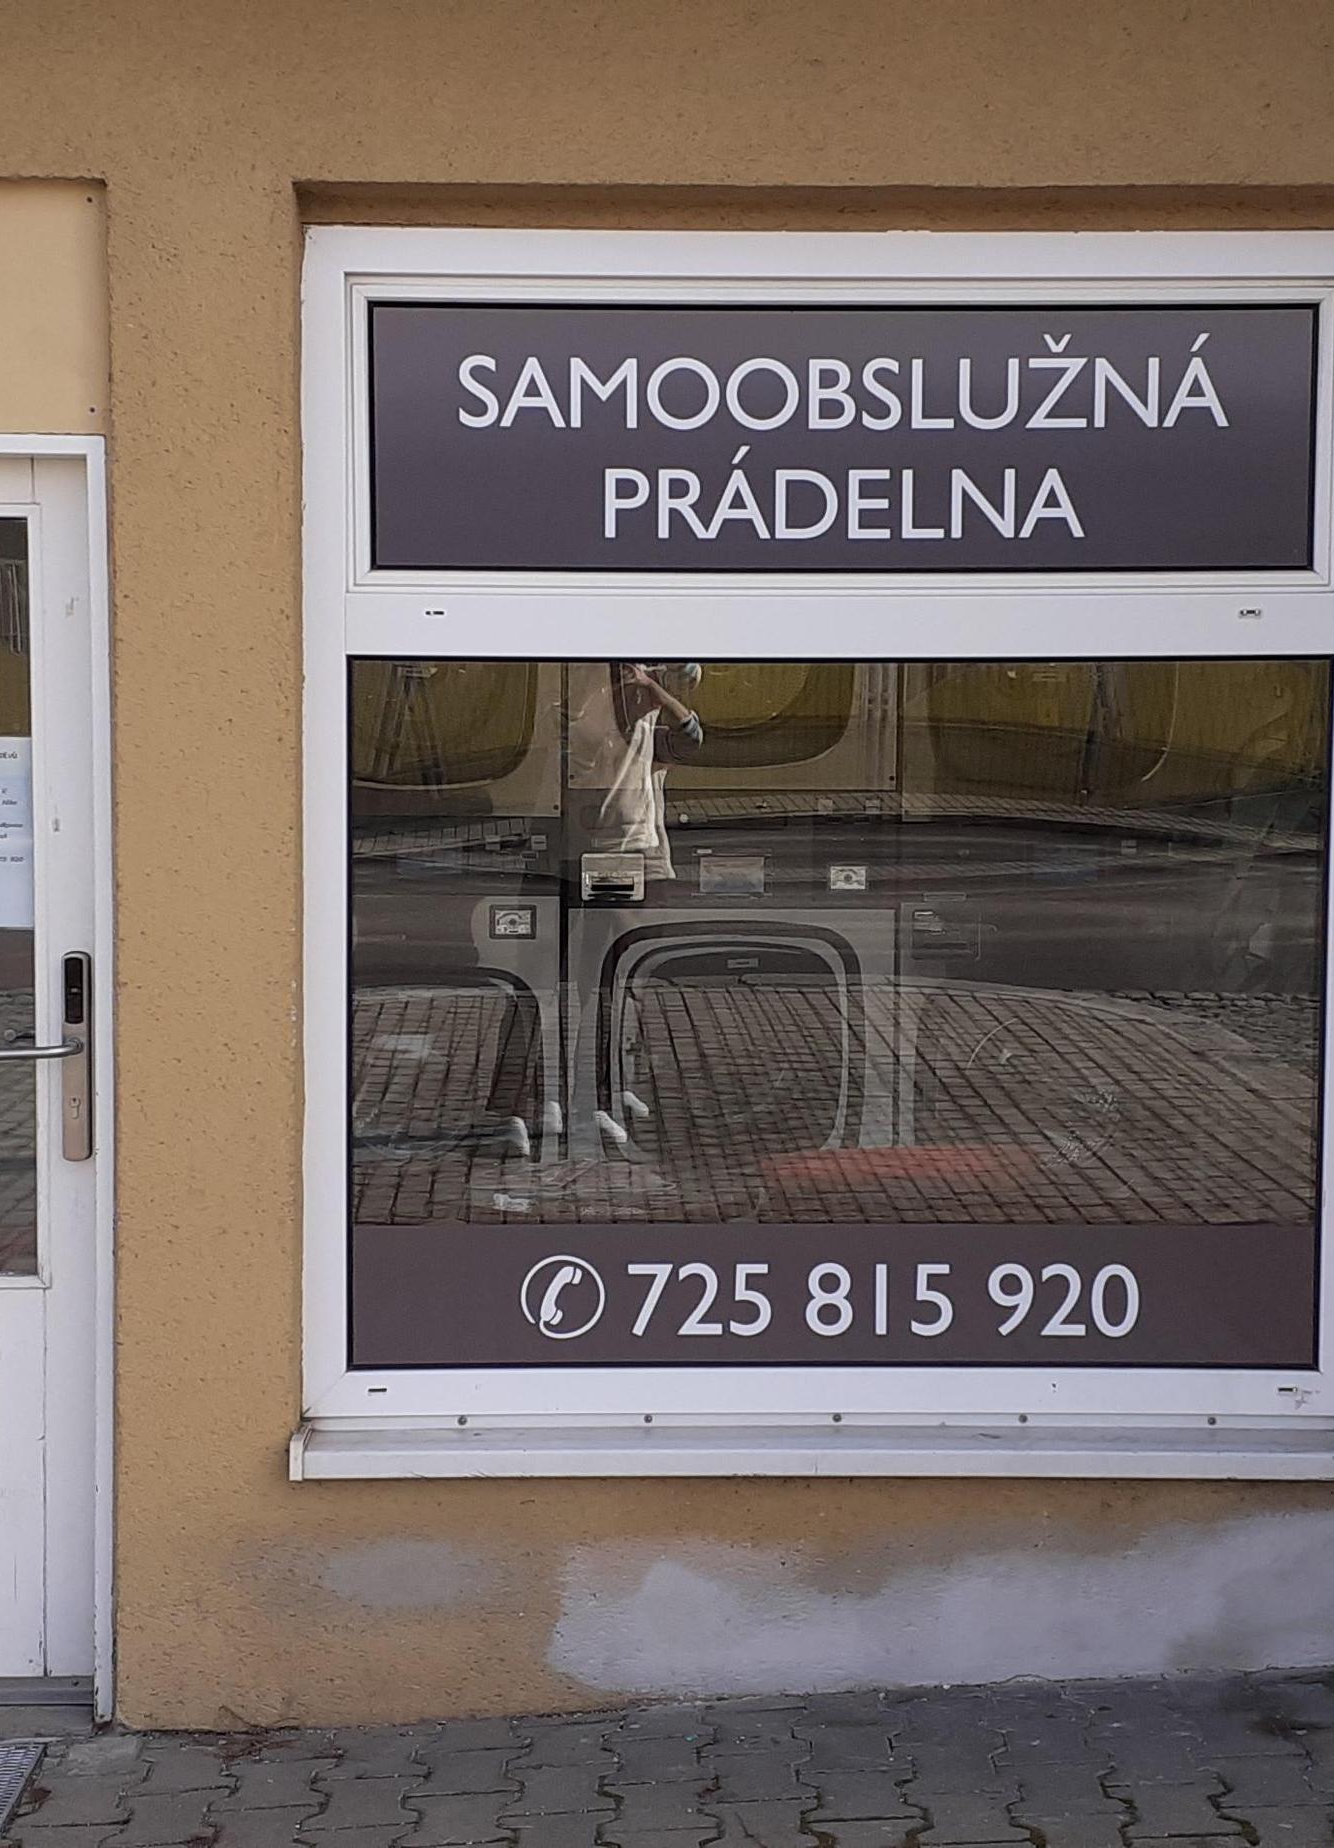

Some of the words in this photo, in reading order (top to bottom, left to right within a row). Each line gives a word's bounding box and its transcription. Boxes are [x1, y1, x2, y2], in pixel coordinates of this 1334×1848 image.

[459, 333, 1228, 430] SAMOOBSLUŽNÁ
[605, 446, 1084, 538] PRÁDELNA
[628, 1263, 771, 1336] 725
[806, 1263, 952, 1336] 815
[989, 1264, 1138, 1336] 920
